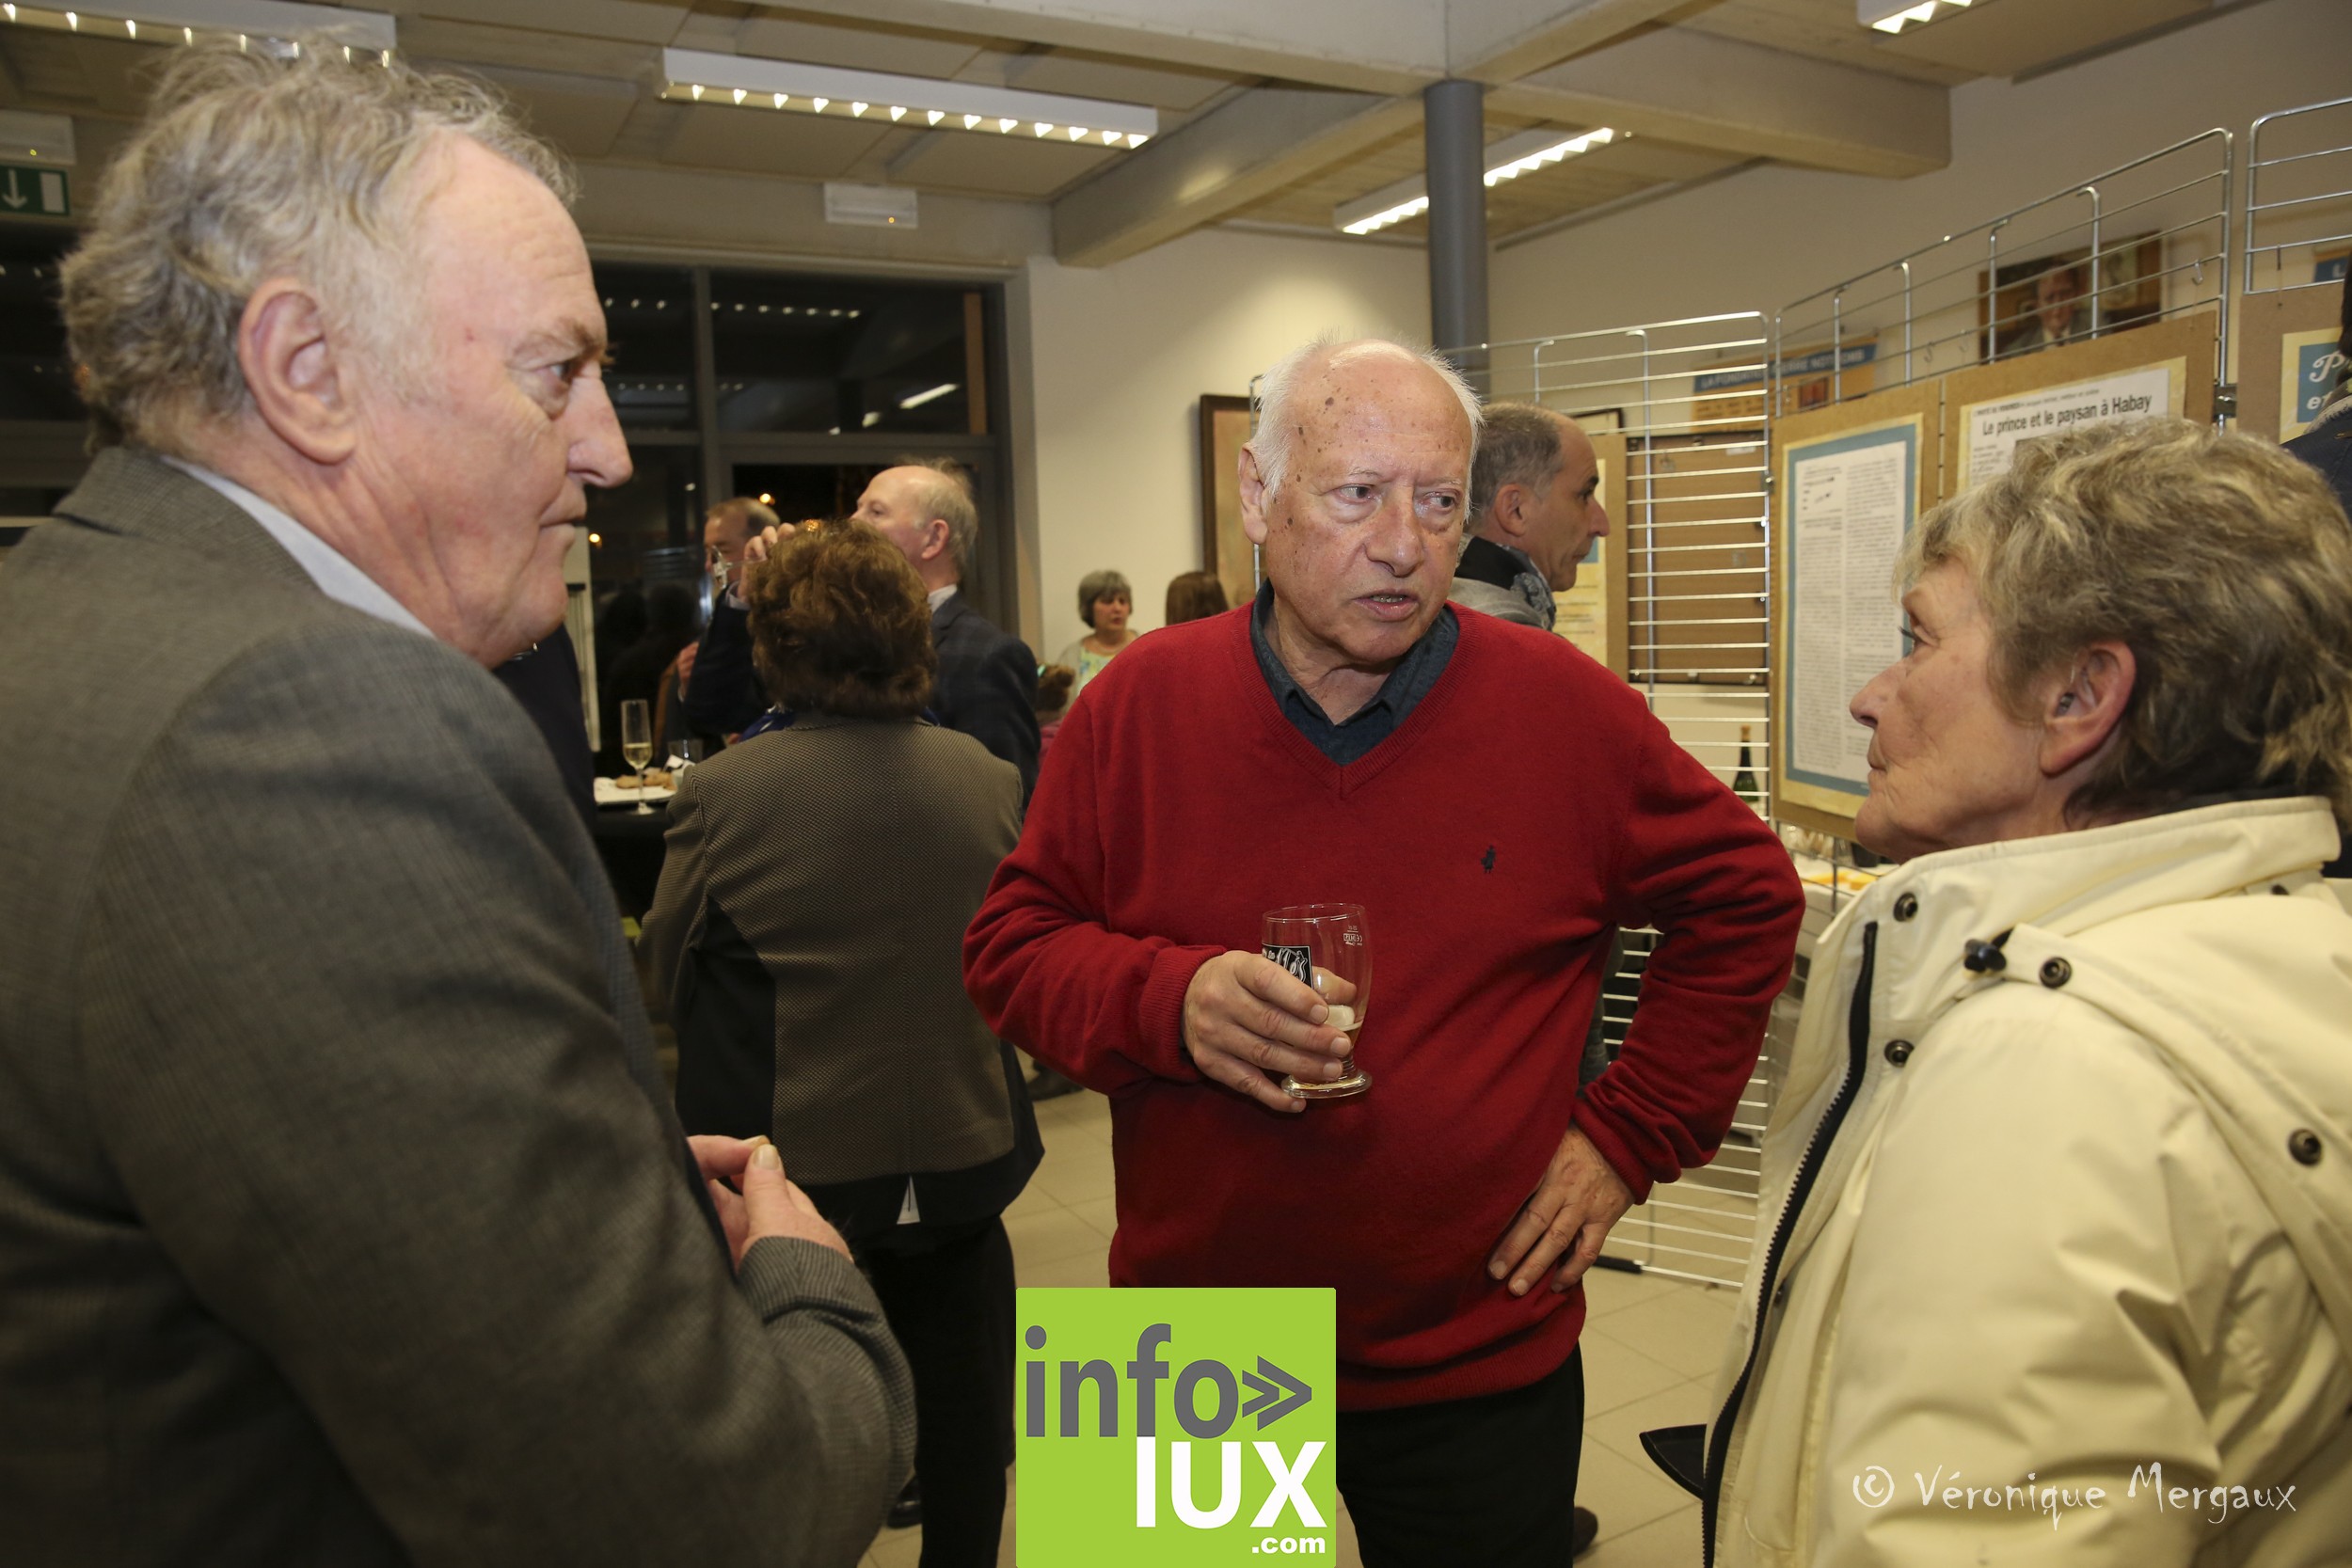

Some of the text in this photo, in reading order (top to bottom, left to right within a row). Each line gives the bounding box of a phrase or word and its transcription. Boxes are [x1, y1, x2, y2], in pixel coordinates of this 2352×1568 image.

[1982, 420, 1995, 436] Le
[1996, 417, 2027, 437] prince
[2029, 411, 2042, 428] et
[2043, 409, 2055, 425] le
[2057, 404, 2098, 427] paysan
[2100, 398, 2108, 416] à
[2112, 393, 2153, 415] Habay
